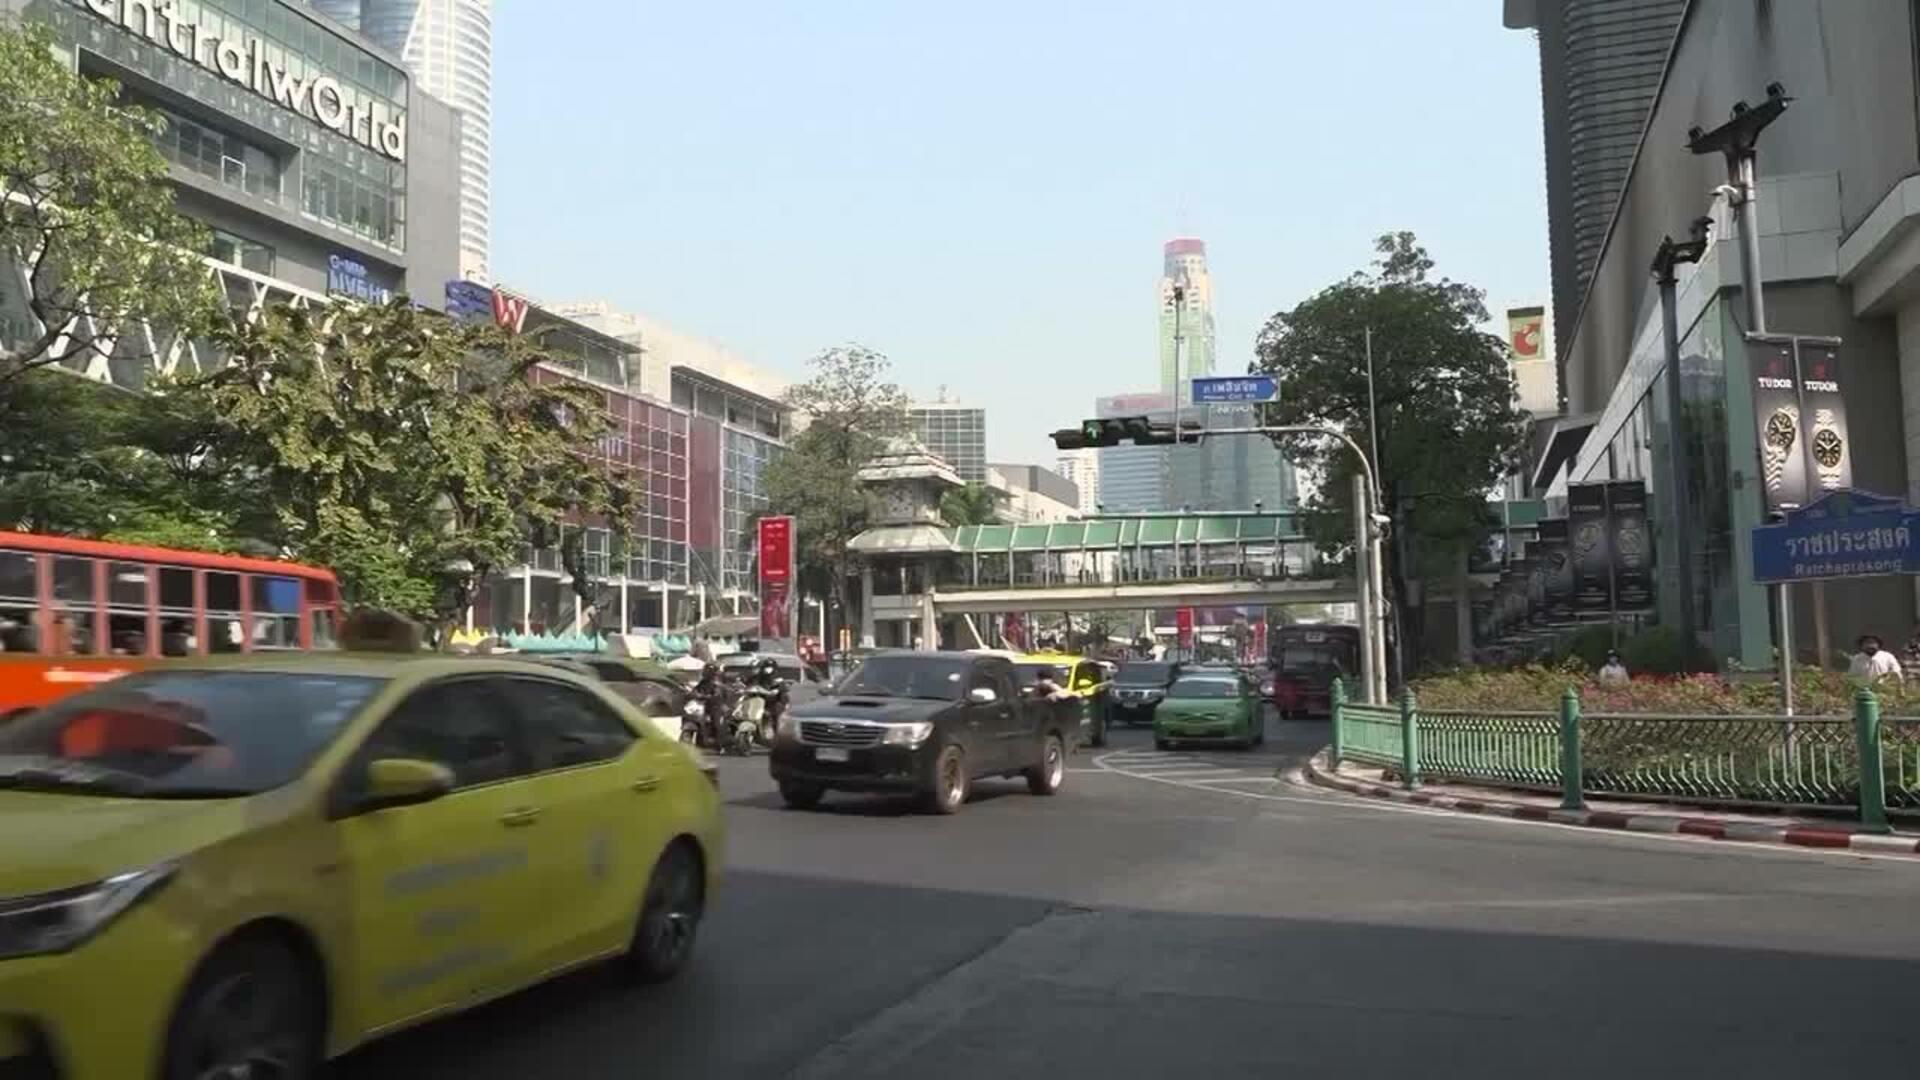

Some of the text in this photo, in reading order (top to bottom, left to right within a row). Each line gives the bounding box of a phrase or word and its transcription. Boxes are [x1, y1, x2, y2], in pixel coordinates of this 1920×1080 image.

[491, 287, 528, 335] W
[1757, 377, 1793, 389] TUDOR
[1804, 380, 1839, 392] TUDOR
[1785, 518, 1912, 557] ราชประสงค์
